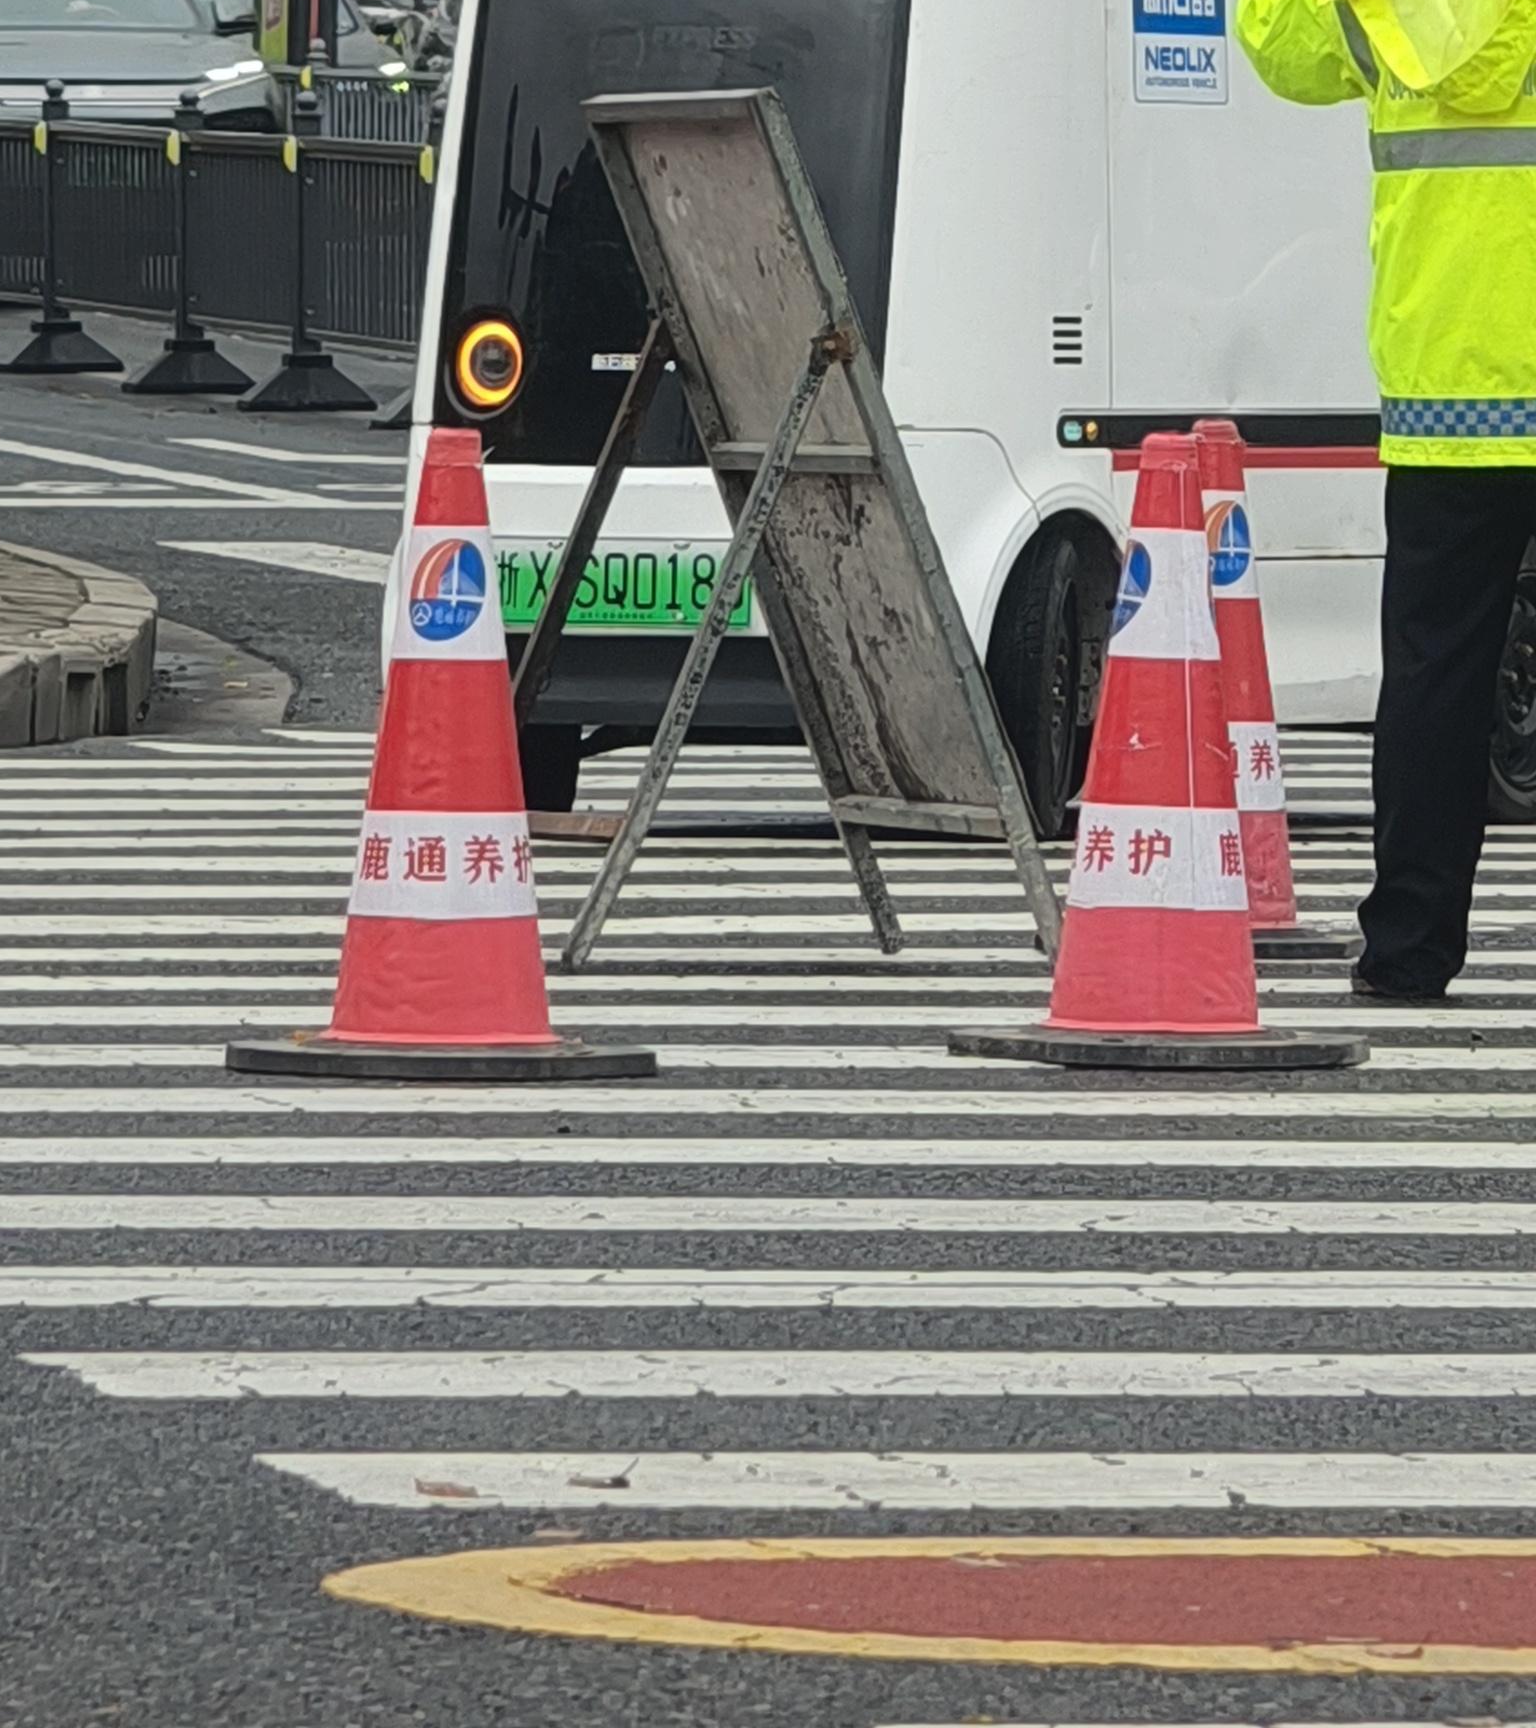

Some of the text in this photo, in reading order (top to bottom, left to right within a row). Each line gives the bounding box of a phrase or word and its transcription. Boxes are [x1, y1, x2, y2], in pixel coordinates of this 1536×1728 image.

[1145, 46, 1216, 74] NEOLIX
[360, 832, 533, 884] 鹿通养护
